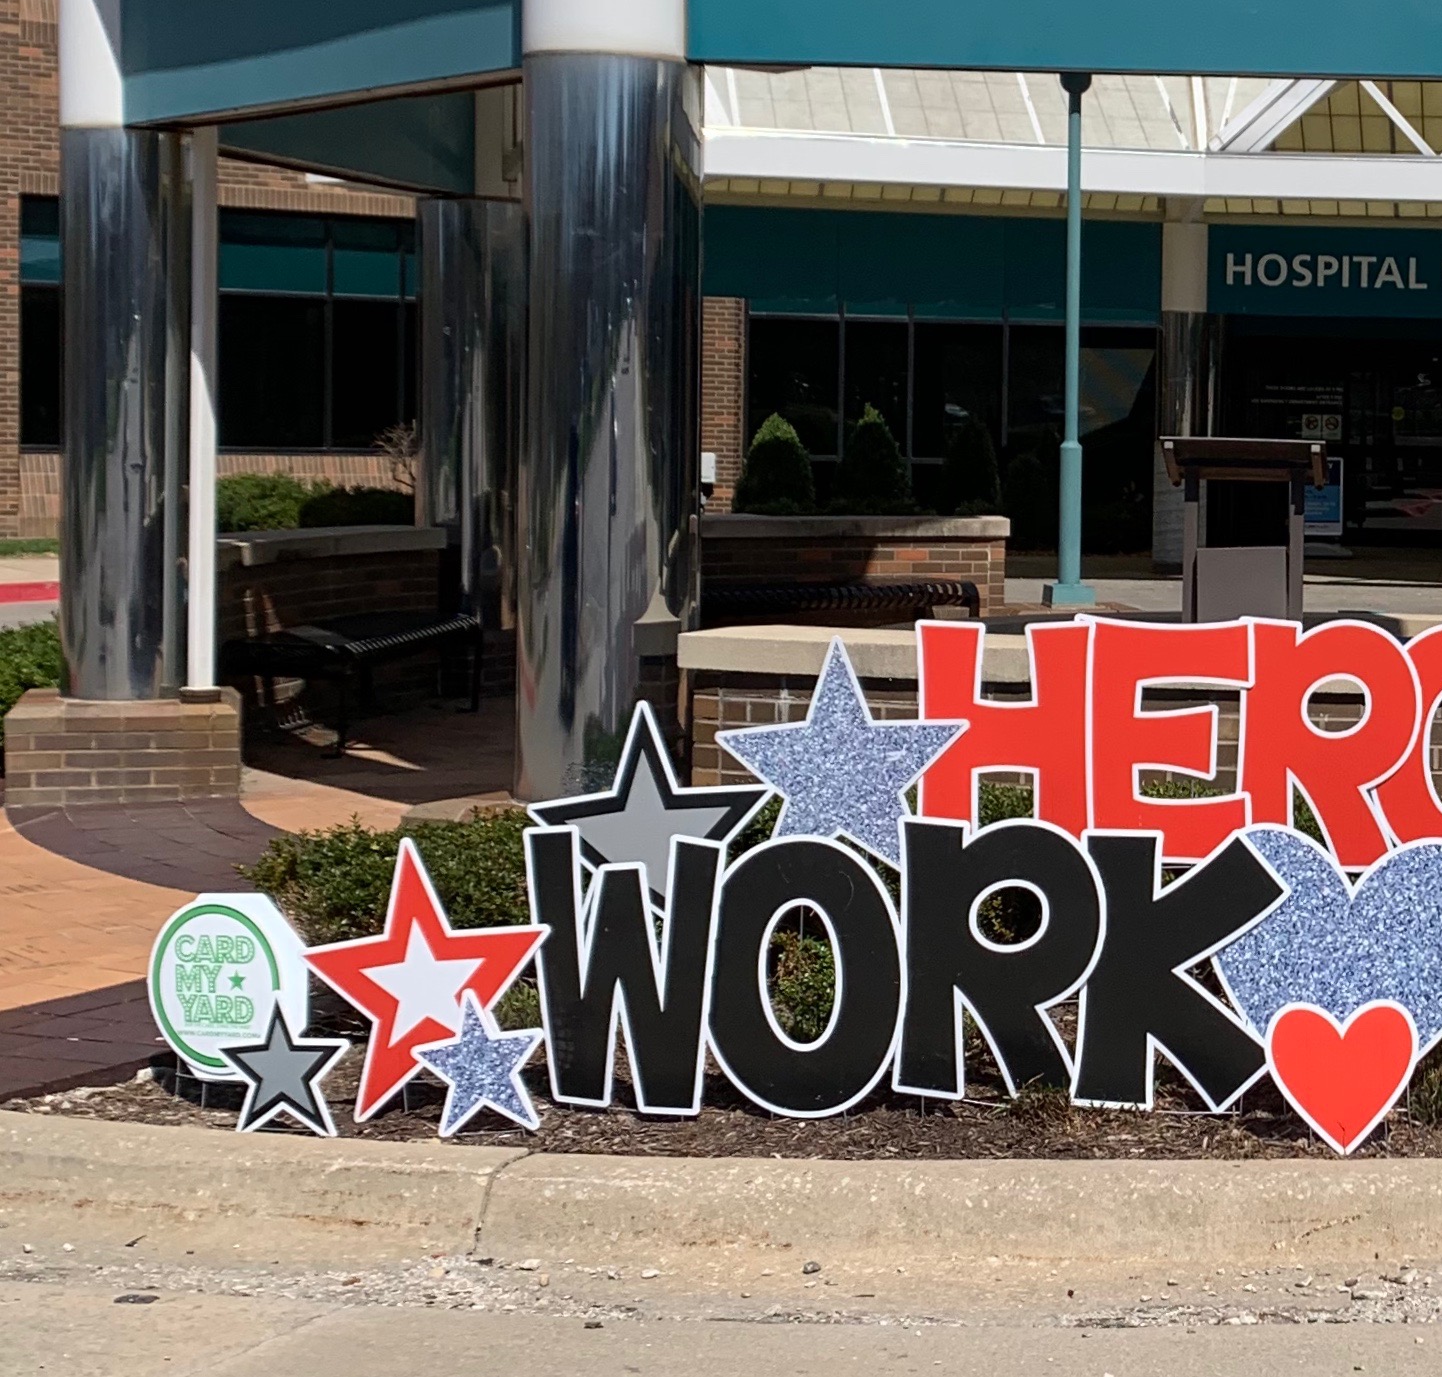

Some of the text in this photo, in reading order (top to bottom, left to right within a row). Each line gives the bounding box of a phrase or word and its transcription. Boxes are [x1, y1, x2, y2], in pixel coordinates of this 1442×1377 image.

[1225, 252, 1428, 290] HOSPITAL
[174, 934, 256, 964] CARD
[175, 964, 222, 994] MY
[524, 815, 1291, 1118] WORK
[177, 994, 255, 1024] YARD
